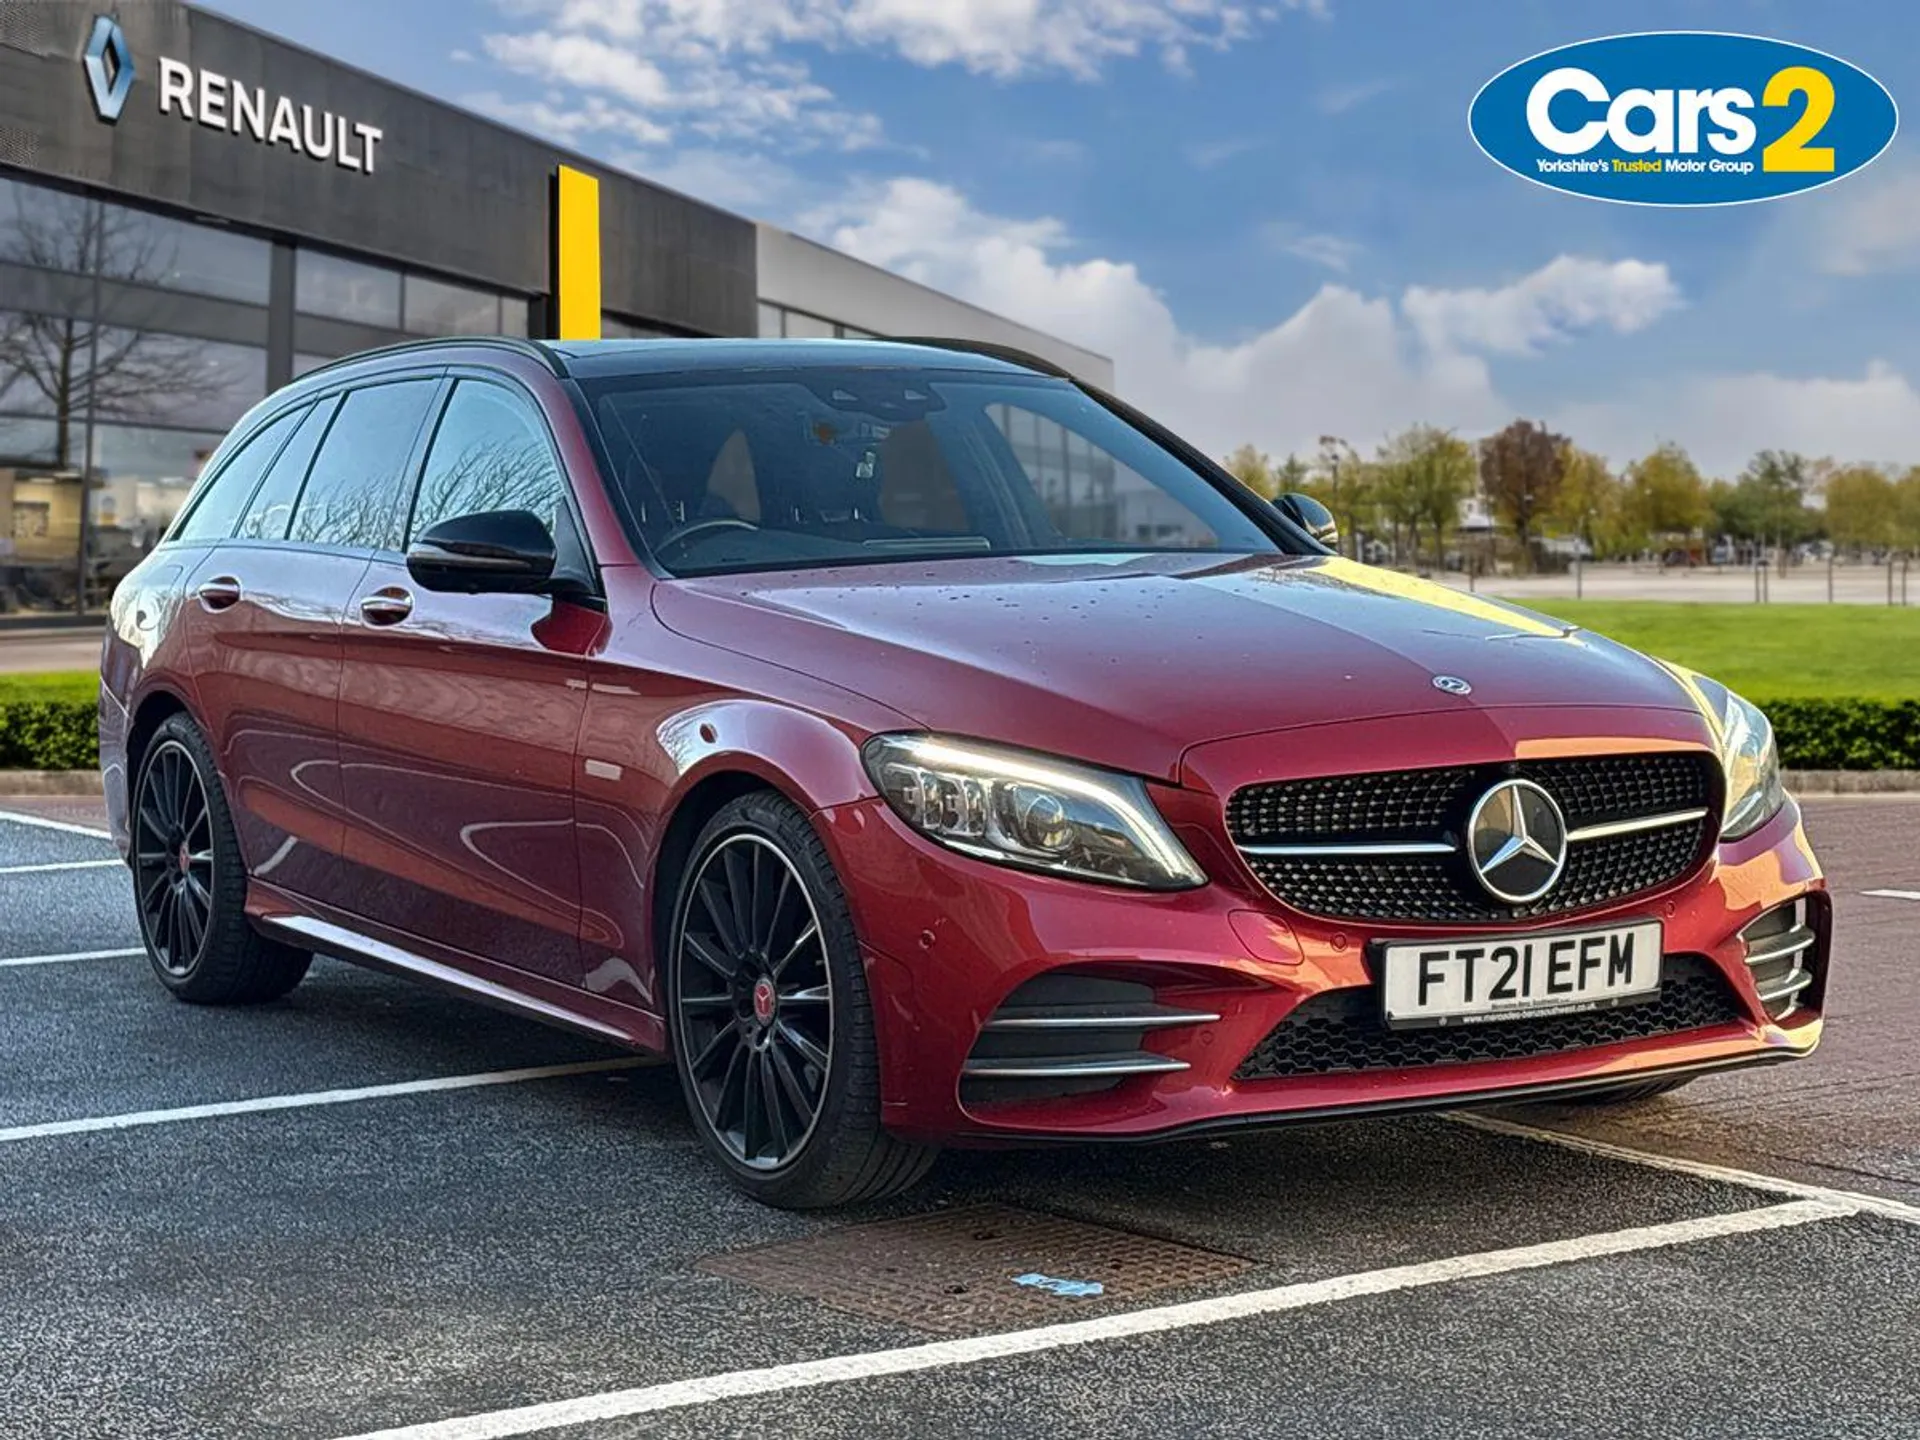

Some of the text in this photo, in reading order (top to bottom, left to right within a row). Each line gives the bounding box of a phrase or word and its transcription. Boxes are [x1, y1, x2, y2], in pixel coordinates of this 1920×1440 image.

[158, 56, 383, 173] RENAULT
[1417, 932, 1635, 1006] FT21 EFM
